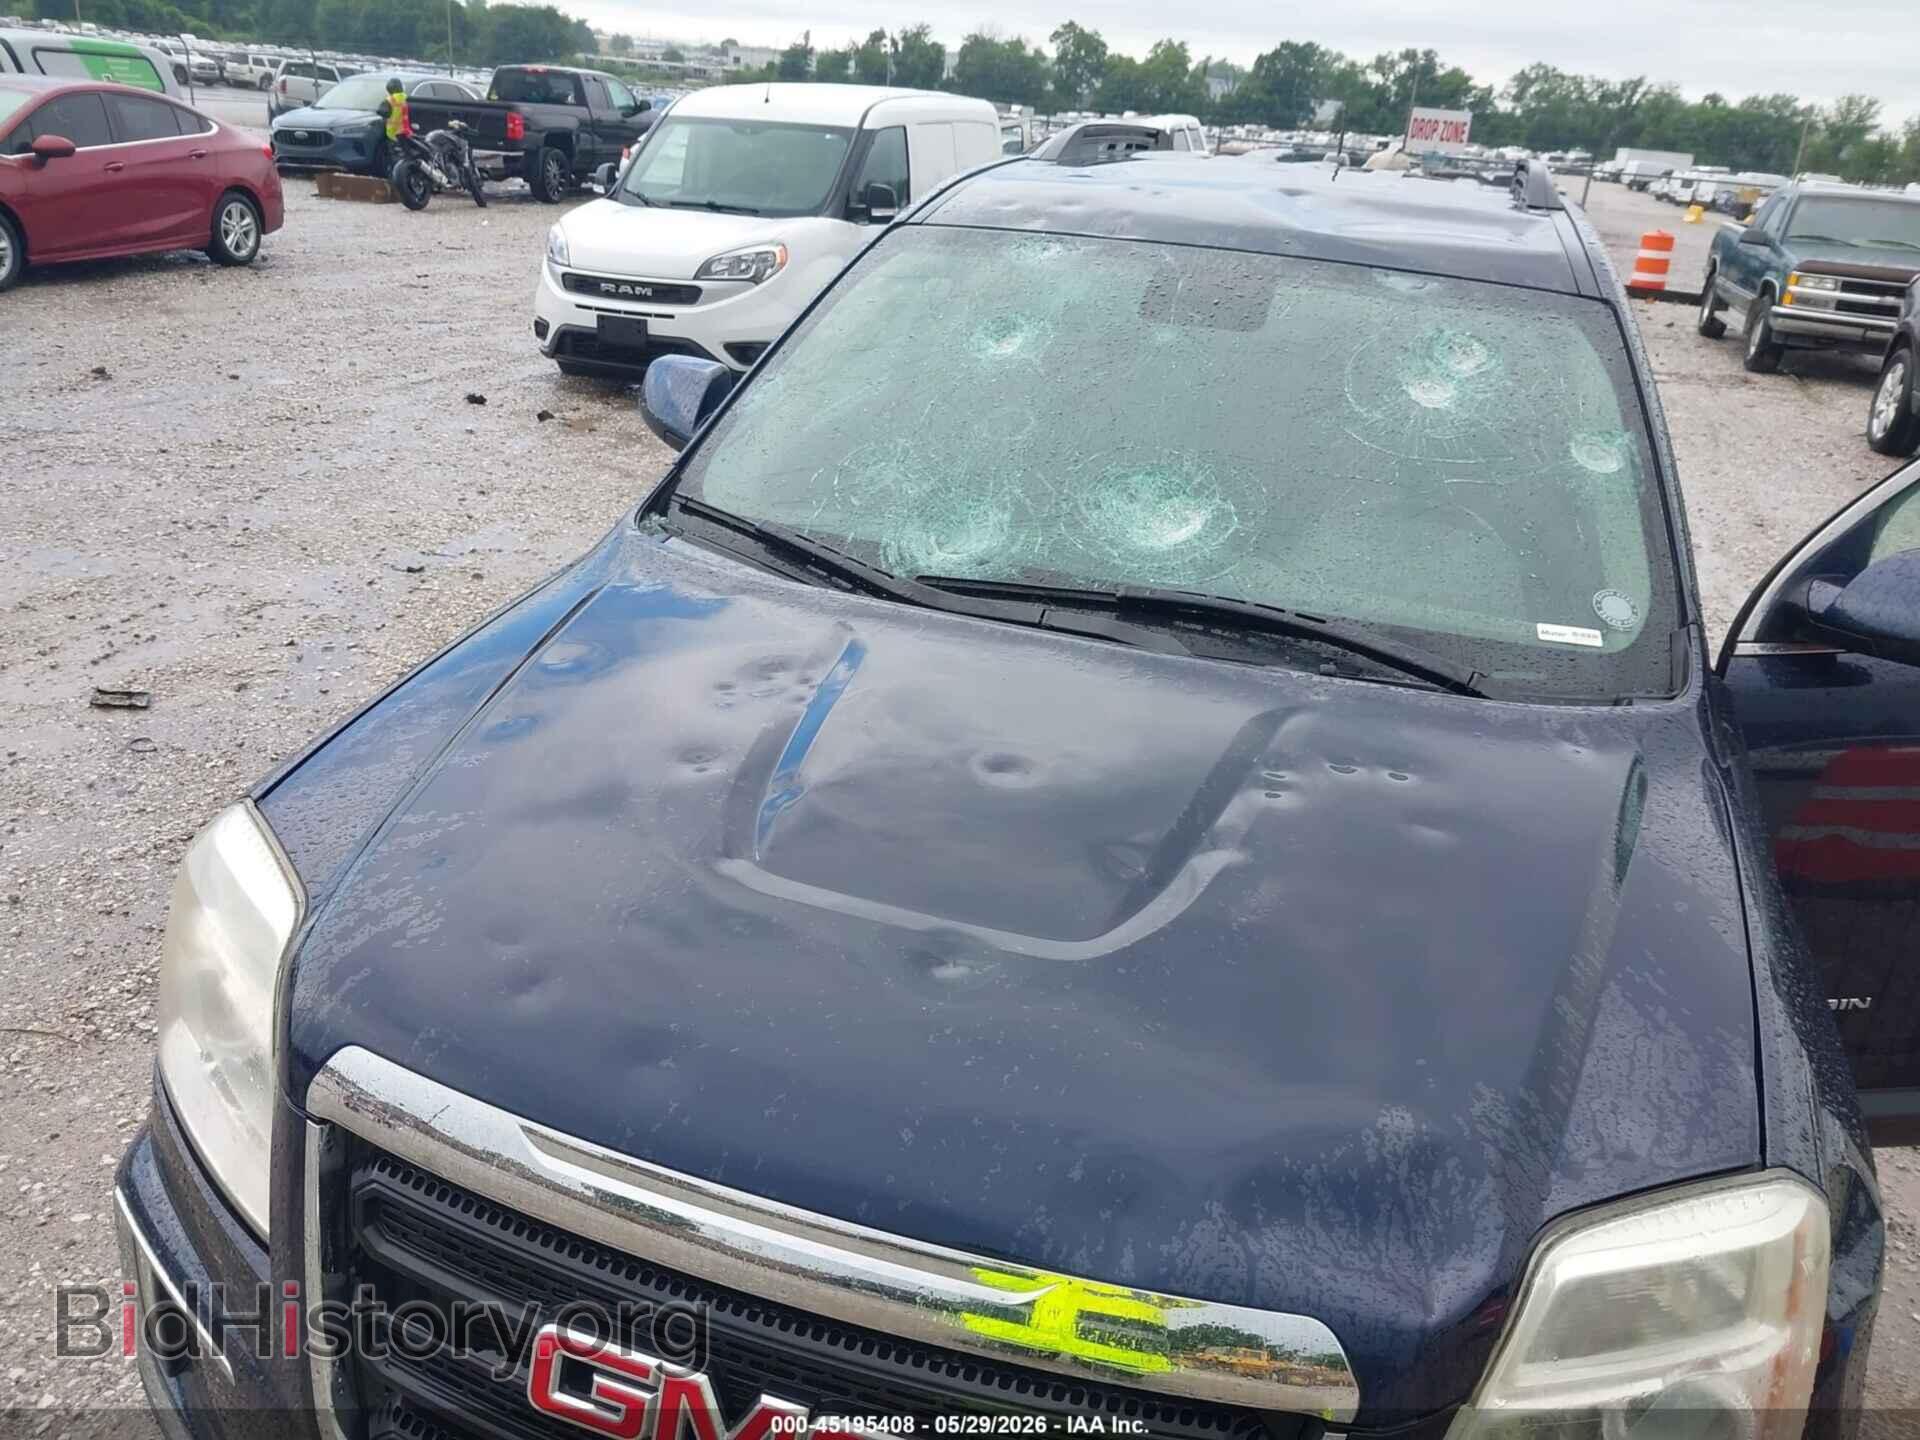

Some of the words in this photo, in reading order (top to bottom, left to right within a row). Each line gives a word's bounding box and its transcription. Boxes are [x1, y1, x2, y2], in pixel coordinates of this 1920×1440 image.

[1410, 117, 1439, 140] DROP
[1440, 120, 1468, 144] ZONE
[600, 283, 653, 297] RAM
[526, 1323, 905, 1440] GM
